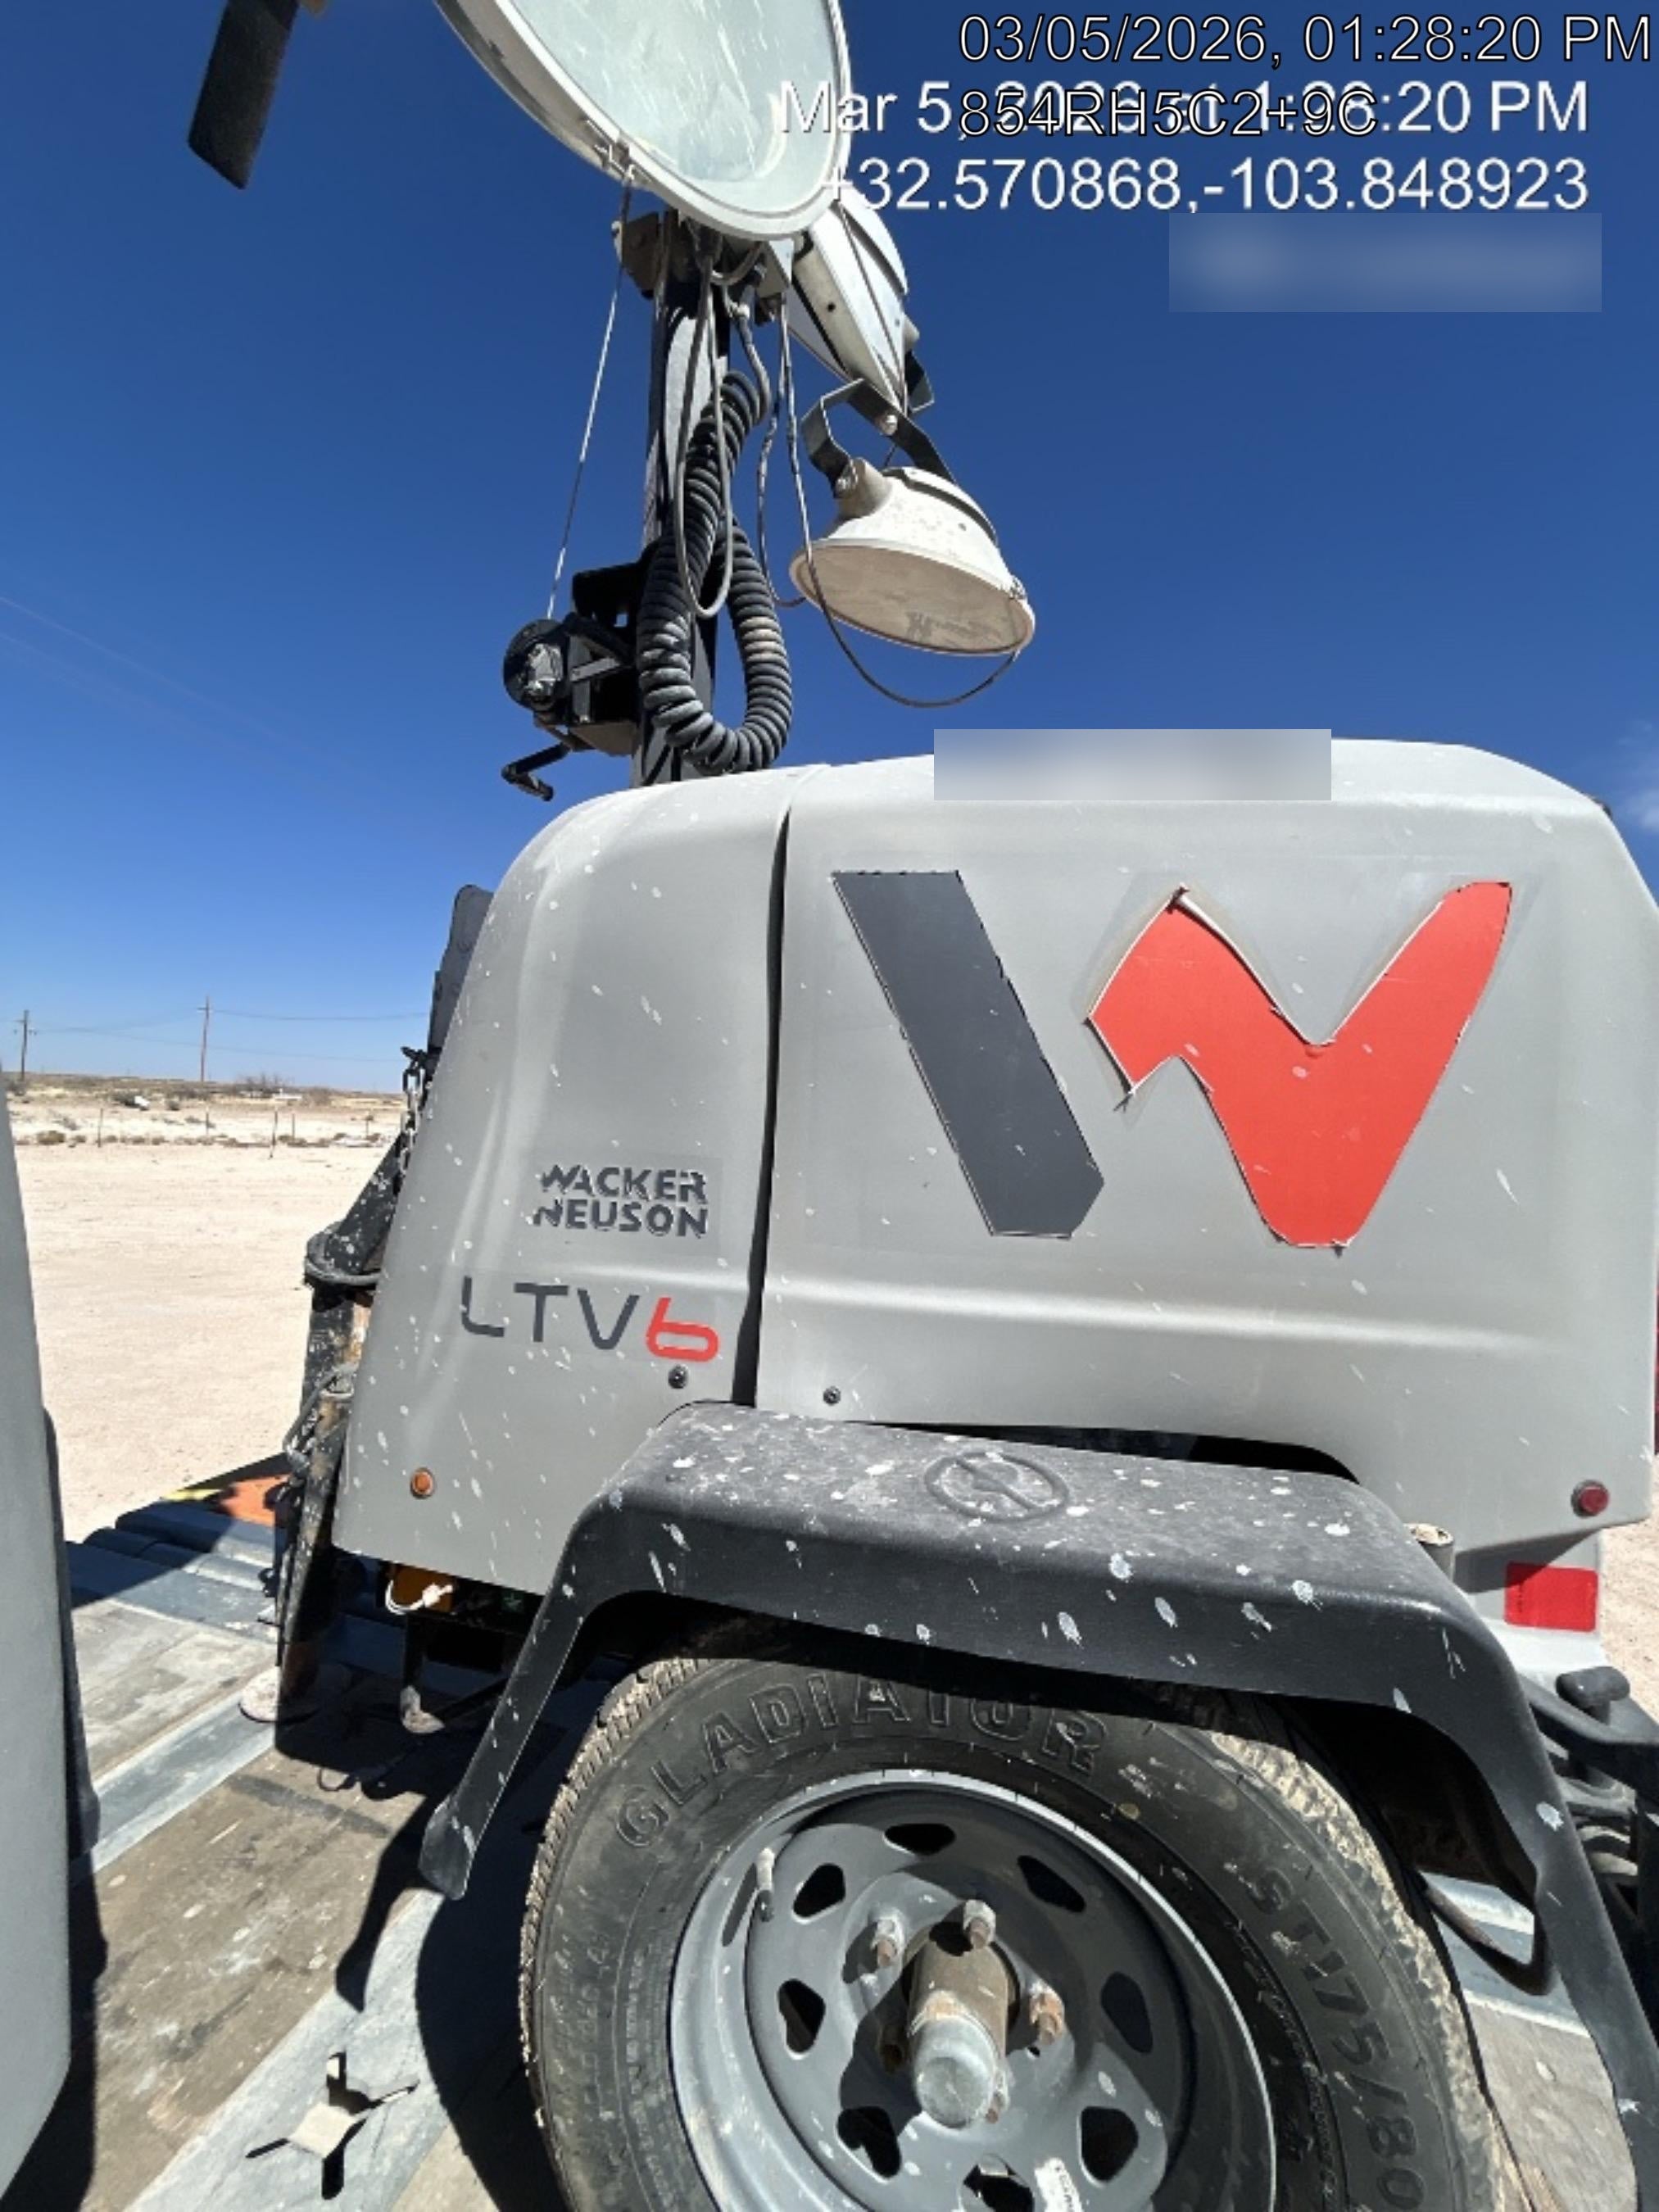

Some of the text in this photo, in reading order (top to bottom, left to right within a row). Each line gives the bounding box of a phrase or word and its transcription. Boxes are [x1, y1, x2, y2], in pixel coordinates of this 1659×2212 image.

[540, 1164, 709, 1205] WACKER
[533, 1198, 709, 1240] NEUSON
[461, 1275, 720, 1362] LTV6
